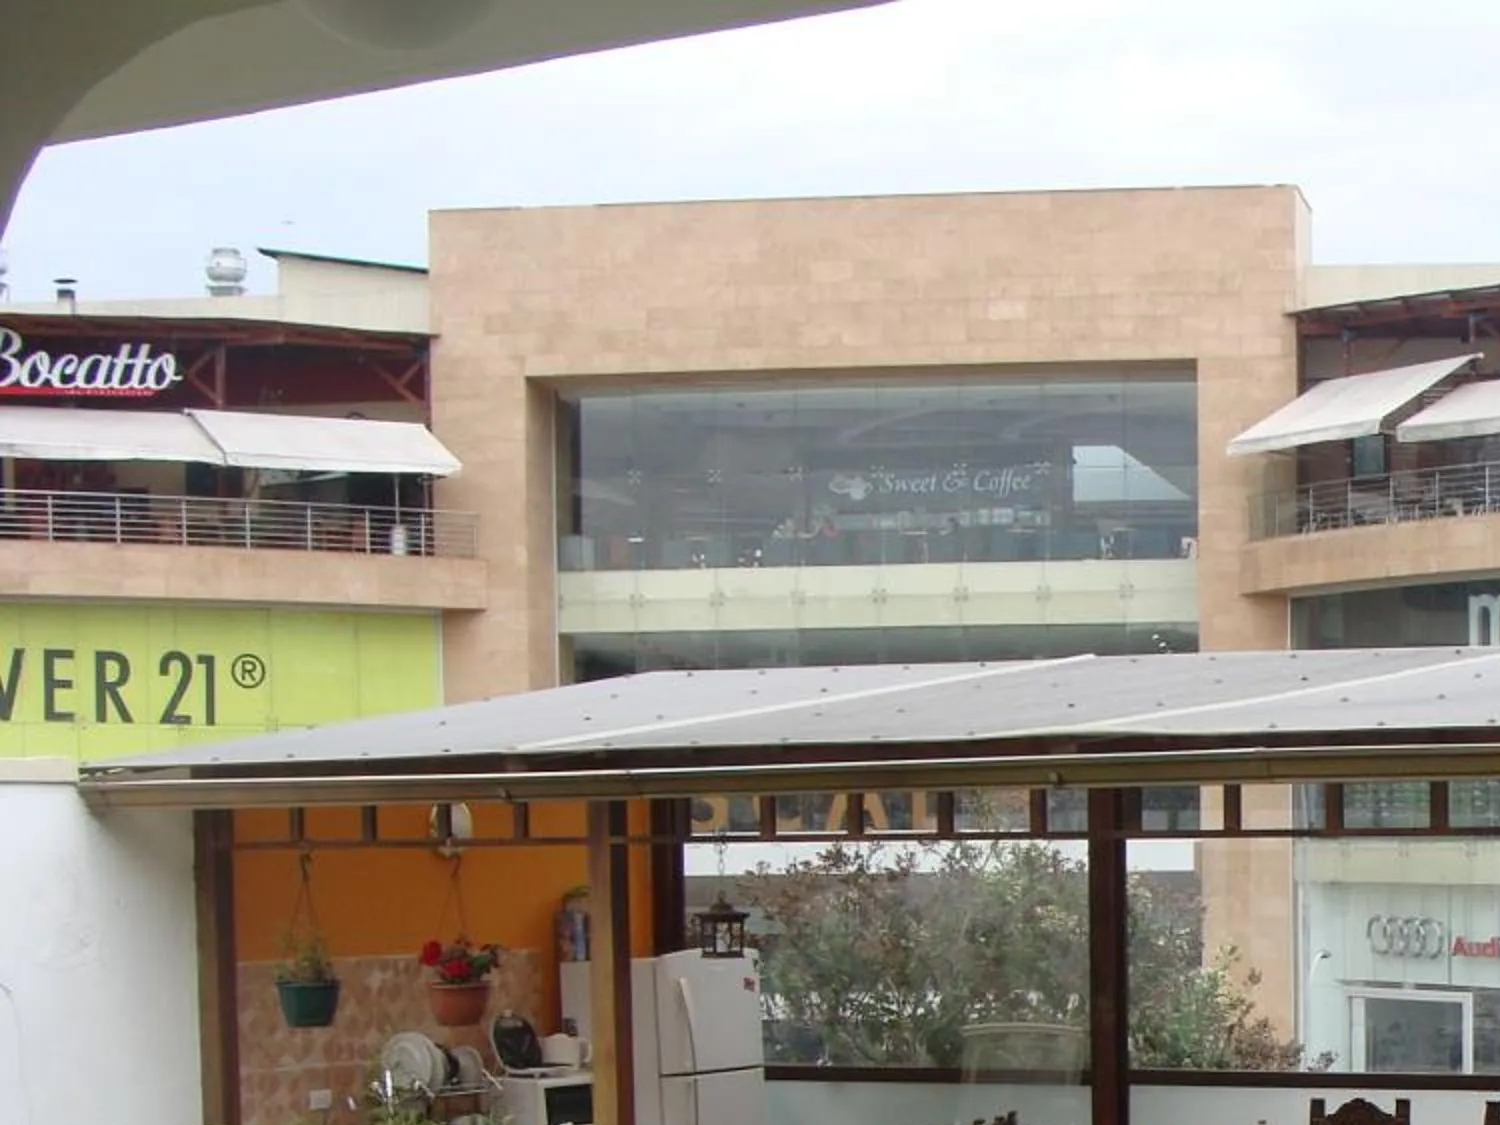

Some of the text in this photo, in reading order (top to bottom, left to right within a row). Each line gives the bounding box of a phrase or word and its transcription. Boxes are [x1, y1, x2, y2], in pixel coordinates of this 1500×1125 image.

[0, 327, 183, 390] Bocatto
[878, 468, 1032, 497] Sweet & Coffee
